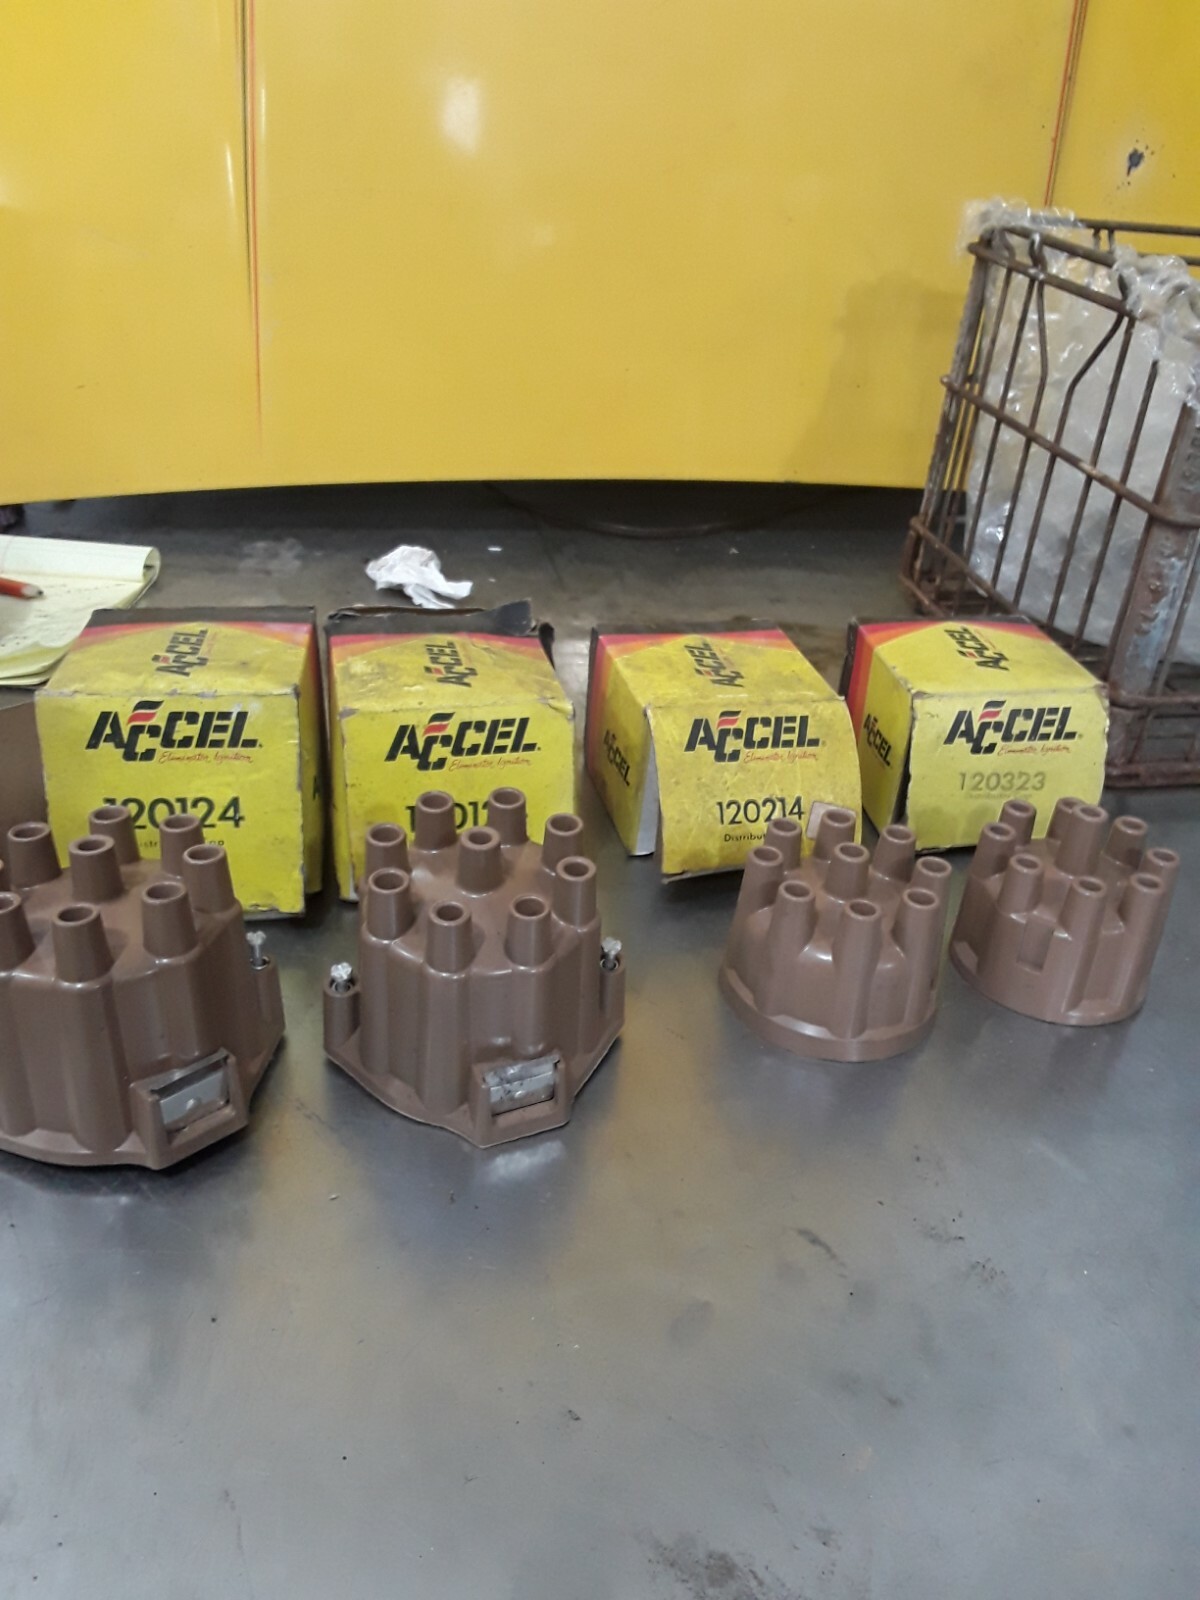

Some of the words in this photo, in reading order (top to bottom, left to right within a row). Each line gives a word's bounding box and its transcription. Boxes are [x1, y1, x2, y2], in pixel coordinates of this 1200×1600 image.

[152, 629, 209, 677] ACCEL
[424, 641, 478, 687] ACCEL
[684, 640, 744, 687] ACCEL
[944, 626, 1009, 671] ACCEL
[85, 701, 258, 762] ACCEL
[384, 712, 537, 771] ACCEL
[684, 711, 820, 762] ACCEL
[864, 714, 891, 766] ACCEL
[943, 700, 1077, 755] ACCEL
[603, 730, 630, 786] ACCEL
[959, 771, 1047, 791] 120323
[103, 797, 245, 829] 20124
[716, 796, 804, 825] 120214
